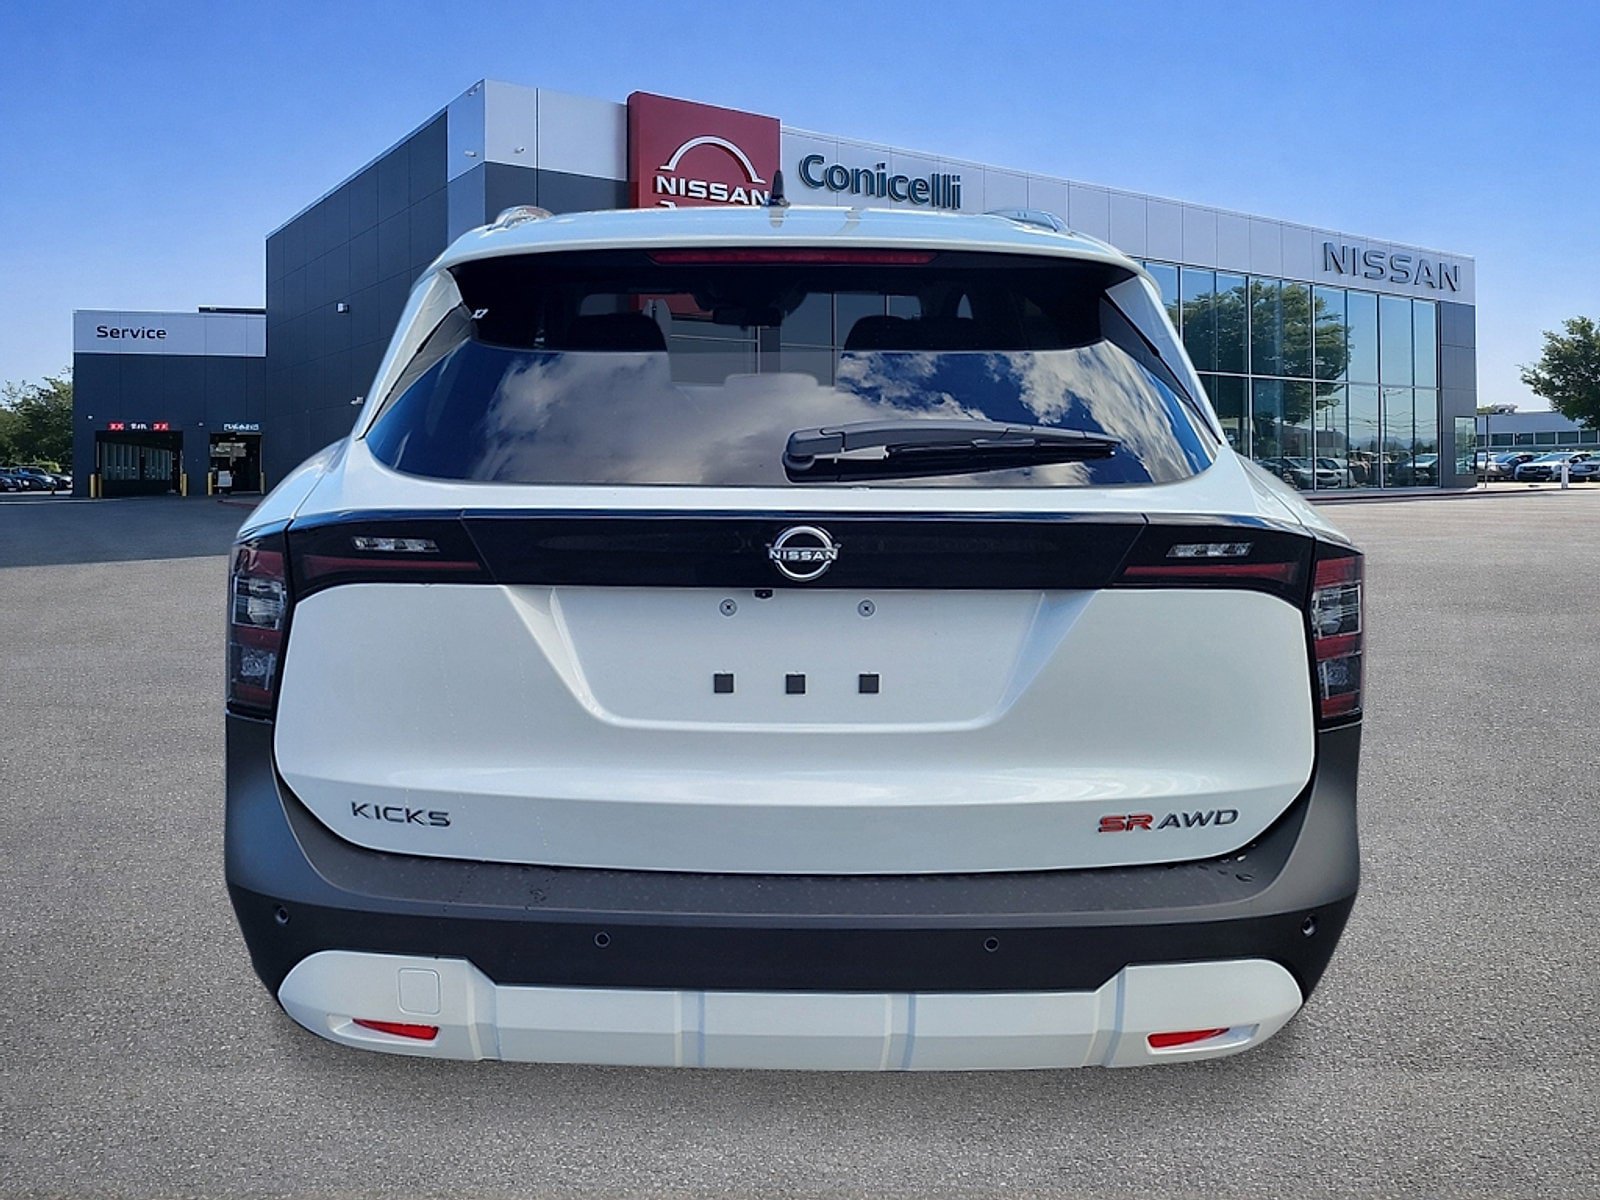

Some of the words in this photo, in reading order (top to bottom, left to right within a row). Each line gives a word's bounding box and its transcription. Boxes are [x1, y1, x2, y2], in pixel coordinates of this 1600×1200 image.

[655, 175, 770, 206] NISSAN
[799, 154, 962, 210] Conicelli
[1323, 242, 1461, 292] NISSAN
[96, 325, 167, 340] Service
[768, 548, 839, 561] NISSAN
[351, 801, 451, 828] KICKS
[1098, 814, 1154, 833] SR
[1156, 809, 1239, 830] AWD
